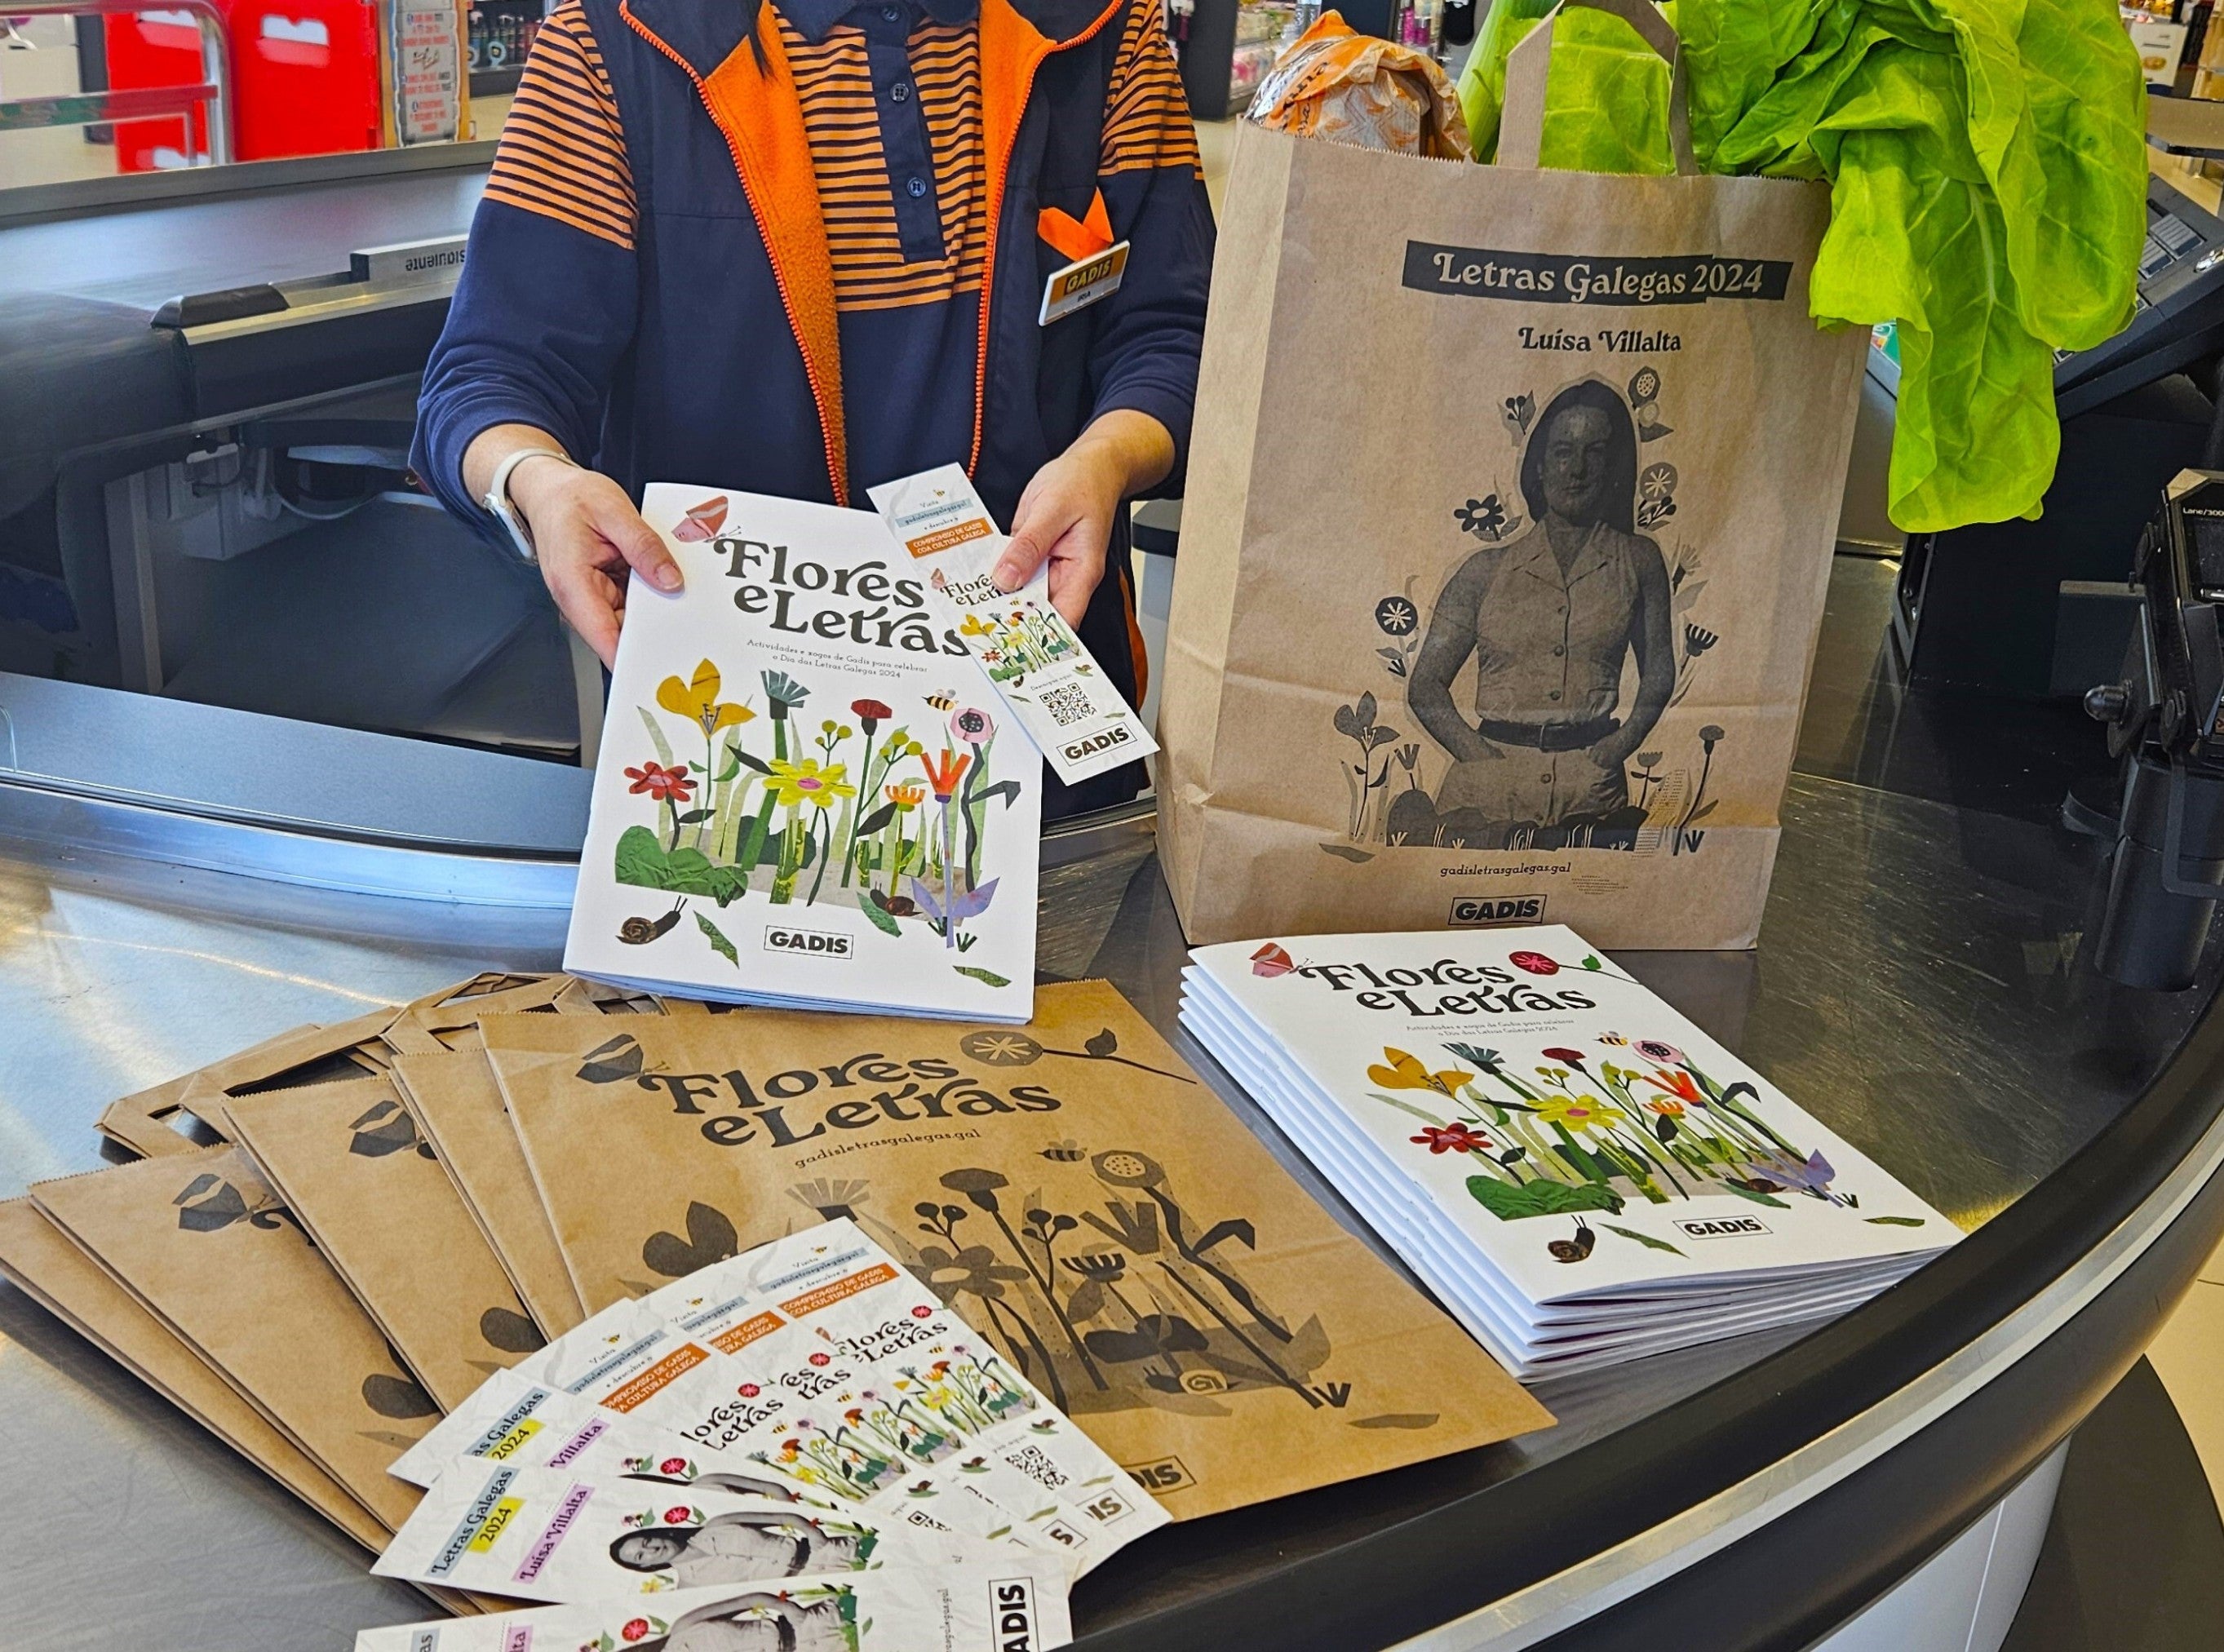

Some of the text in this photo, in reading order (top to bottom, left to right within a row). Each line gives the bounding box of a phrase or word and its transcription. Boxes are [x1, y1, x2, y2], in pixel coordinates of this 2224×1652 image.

[405, 250, 466, 272] siguiente
[1066, 259, 1111, 293] GADIS
[1433, 251, 1763, 303] Letras Galegas 2024
[1518, 327, 1681, 353] Luísa Villalta
[913, 531, 955, 548] COMPROMISO
[955, 528, 965, 536] DE
[917, 546, 933, 554] COA
[932, 537, 962, 550] CULTURA
[713, 538, 925, 609] Flores
[940, 574, 993, 598] Flore
[747, 639, 799, 653] Actividades
[834, 653, 844, 661] de
[846, 655, 871, 665] Gadis
[893, 662, 928, 672] celebrar
[797, 657, 813, 665] das
[814, 659, 841, 670] Letras
[843, 662, 878, 675] Galegas
[879, 670, 901, 678] 2024
[1065, 728, 1129, 760] GADIS
[1440, 862, 1571, 877] gadisletrasgalegas.gal
[1455, 899, 1540, 921] GADIS
[769, 930, 848, 954] GADIS
[1299, 959, 1515, 990] Flores
[638, 1052, 959, 1115] Flores
[795, 1128, 981, 1168] gadisletrasgalegas.gal
[1683, 1217, 1763, 1236] GADIS
[782, 1268, 884, 1311] COMPROMISO DE GADIS
[789, 1274, 889, 1316] COA CULTURA GALEGA
[627, 1356, 700, 1405] CULTURA GALEGA
[653, 1366, 667, 1375] DE
[487, 1393, 543, 1441] Galegas
[680, 1401, 747, 1442] lores
[702, 1399, 784, 1450] Letras
[491, 1428, 529, 1460] 2024
[550, 1426, 602, 1467] Villalta
[431, 1526, 474, 1574] Letras
[467, 1469, 512, 1526] Galegas
[480, 1507, 512, 1543] 2024
[547, 1489, 587, 1537] Villalta
[998, 1584, 1030, 1652] ADIS
